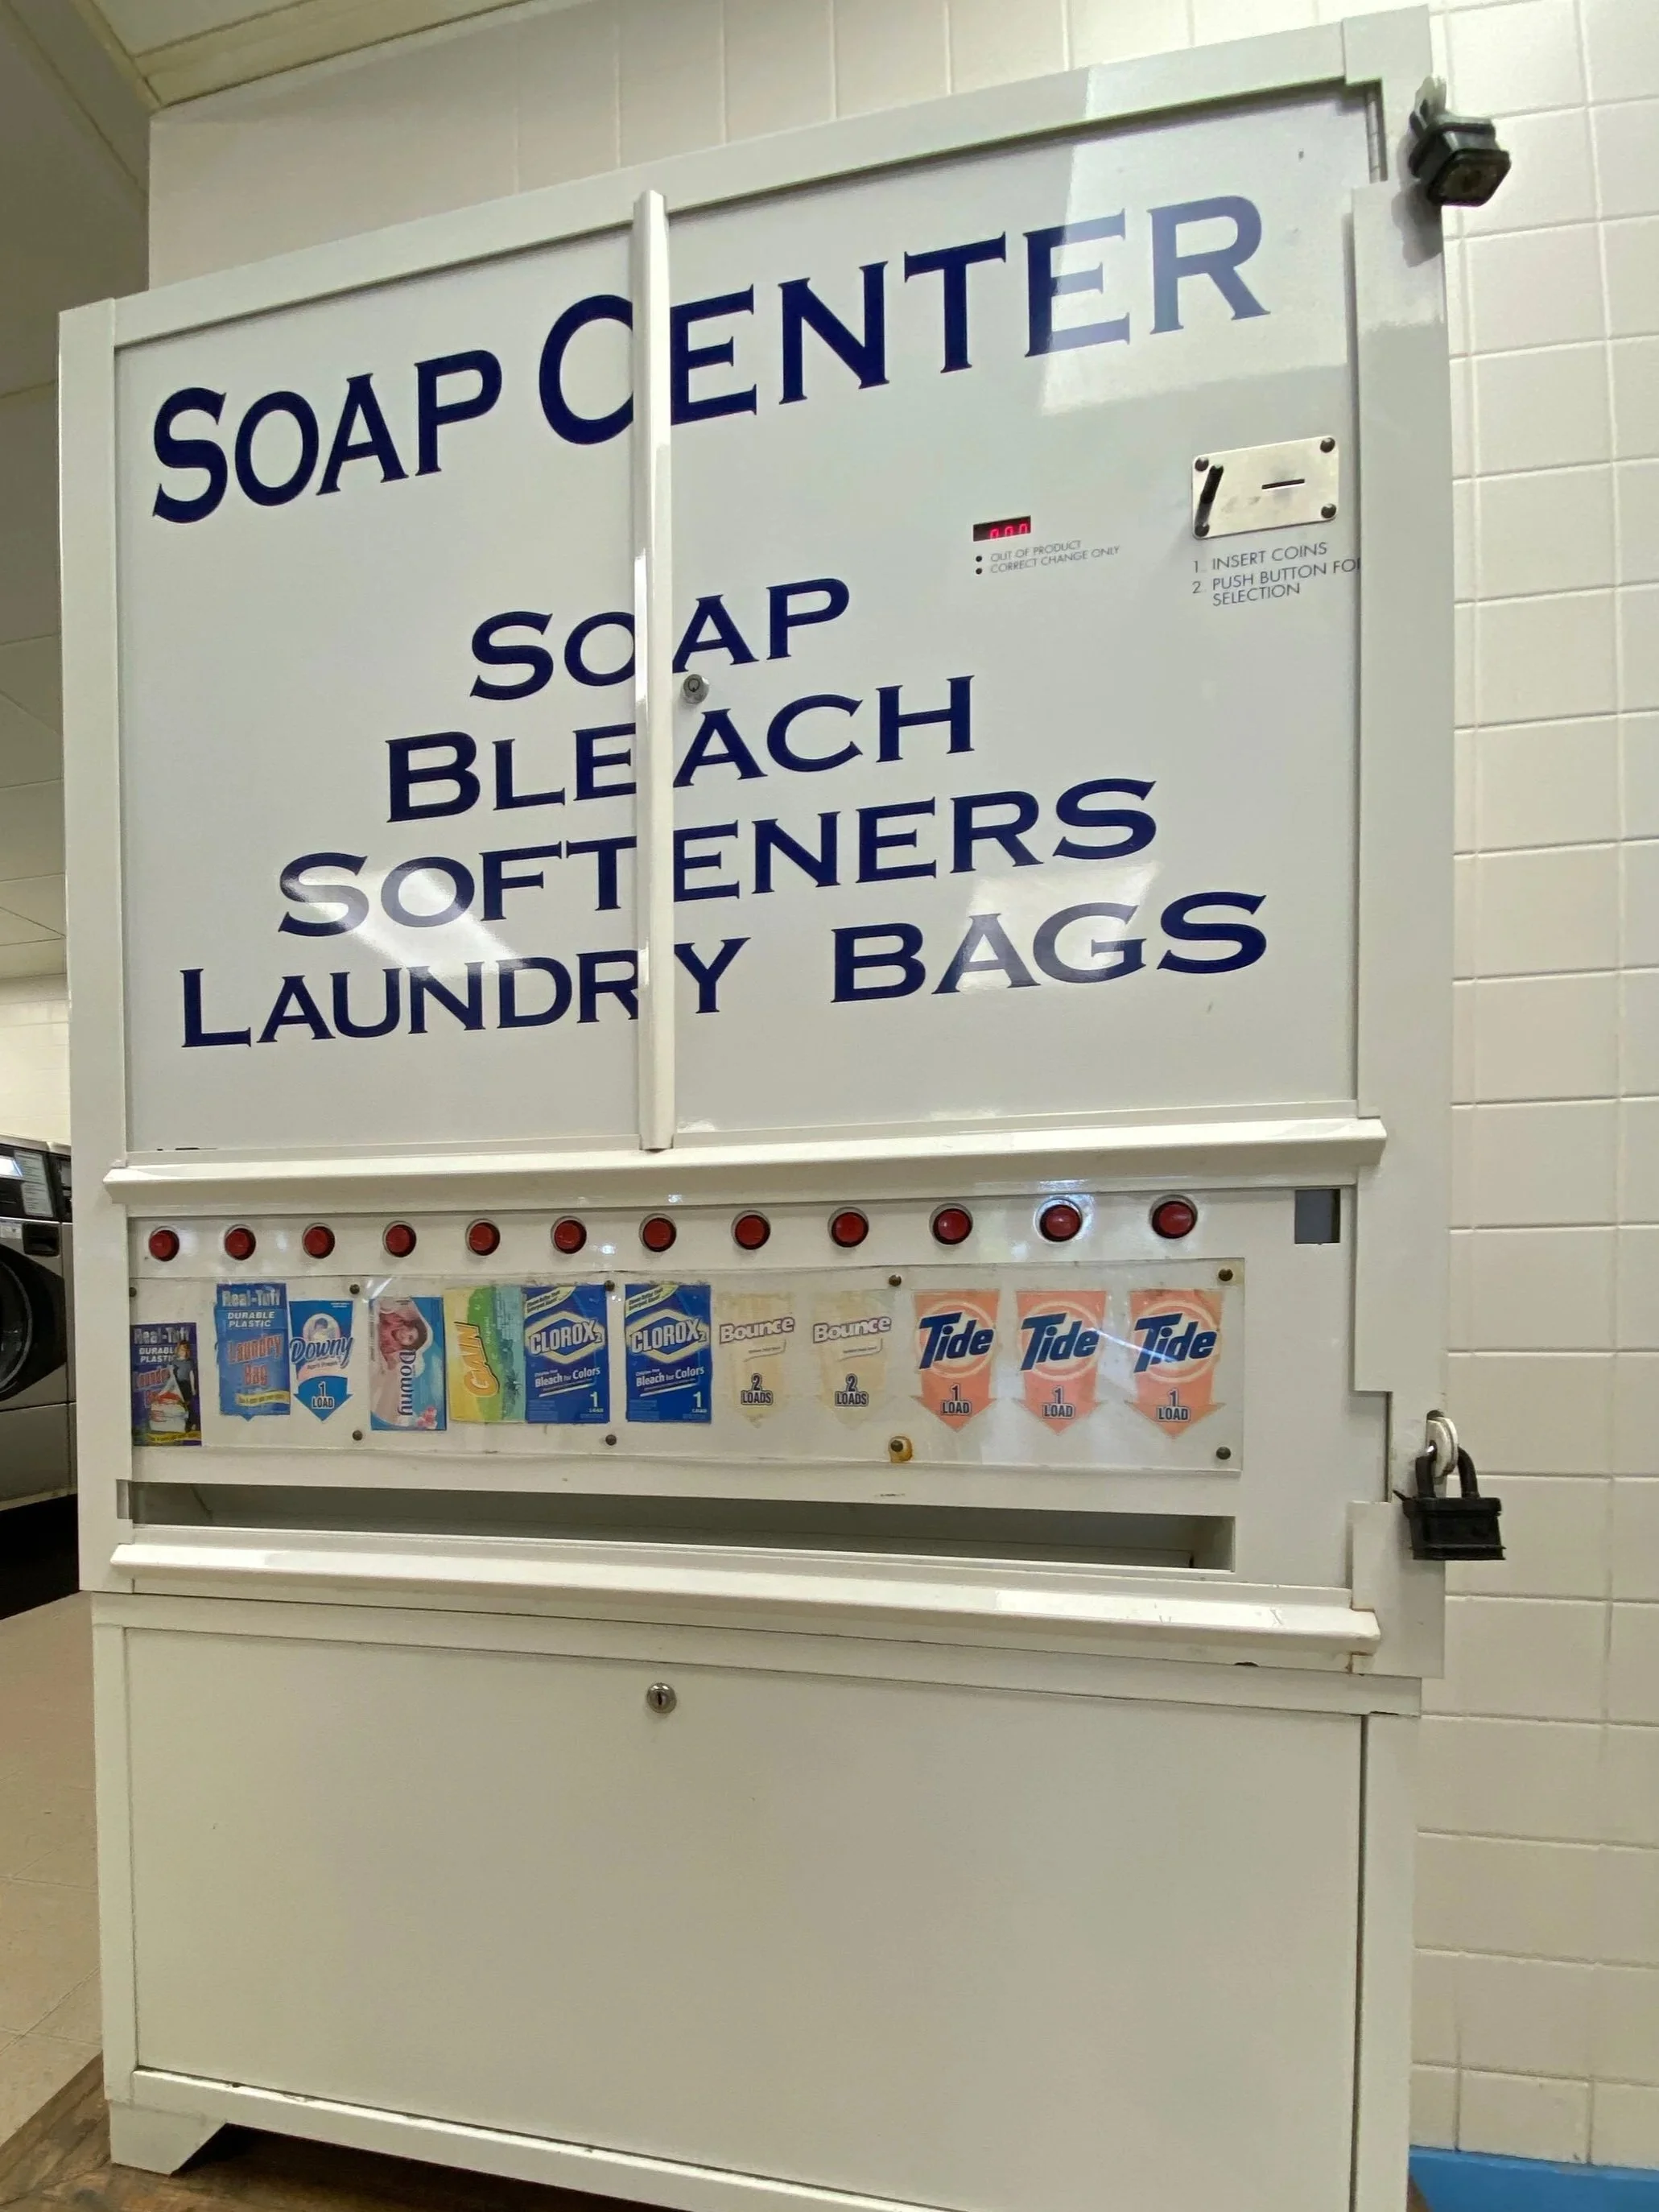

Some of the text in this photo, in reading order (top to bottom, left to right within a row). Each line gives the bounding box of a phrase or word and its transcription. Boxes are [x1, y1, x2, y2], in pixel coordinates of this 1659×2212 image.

[151, 195, 1272, 524] SOAP CENTER
[990, 540, 1082, 563] OUT OF PRODUCT
[990, 545, 1120, 573] CORRECT CHANGE ONLY
[1212, 550, 1267, 571] INSERT
[1271, 542, 1327, 562] COINS
[1212, 573, 1254, 591] PUSH
[1260, 562, 1327, 584] BUTTON
[1212, 583, 1301, 607] SELECTION
[469, 577, 851, 701] SOAP
[385, 675, 976, 823] BLEACH
[278, 778, 1158, 937] SOFTENERS
[180, 891, 1268, 1048] LAUNDRY BAGS
[227, 1311, 276, 1320] DURABLE
[229, 1319, 272, 1328] PLASTIC
[720, 1316, 795, 1344] Bounce
[813, 1316, 891, 1344] Bounce
[918, 1311, 995, 1370] Tide
[139, 1347, 175, 1356] DURABL
[1020, 1312, 1100, 1371] Tide
[1133, 1312, 1218, 1373] Tide
[290, 1337, 353, 1369] Downy
[397, 1351, 416, 1416] Downy
[534, 1373, 563, 1388] Bleach
[572, 1367, 601, 1380] Colors
[636, 1372, 665, 1387] Bleach
[675, 1366, 705, 1380] Colors
[752, 1374, 761, 1391] 2
[847, 1374, 856, 1392] 2
[318, 1381, 325, 1397] 1
[589, 1391, 598, 1407] 1
[692, 1391, 702, 1408] 1
[741, 1391, 772, 1404] LOADS
[836, 1392, 867, 1405] LOADS
[951, 1385, 960, 1401] 1
[1054, 1387, 1063, 1405] 1
[1169, 1389, 1178, 1407] 1
[312, 1397, 334, 1408] LOAD
[942, 1401, 971, 1414] LOAD
[1042, 1405, 1074, 1418] LOAD
[1158, 1407, 1190, 1421] LOAD
